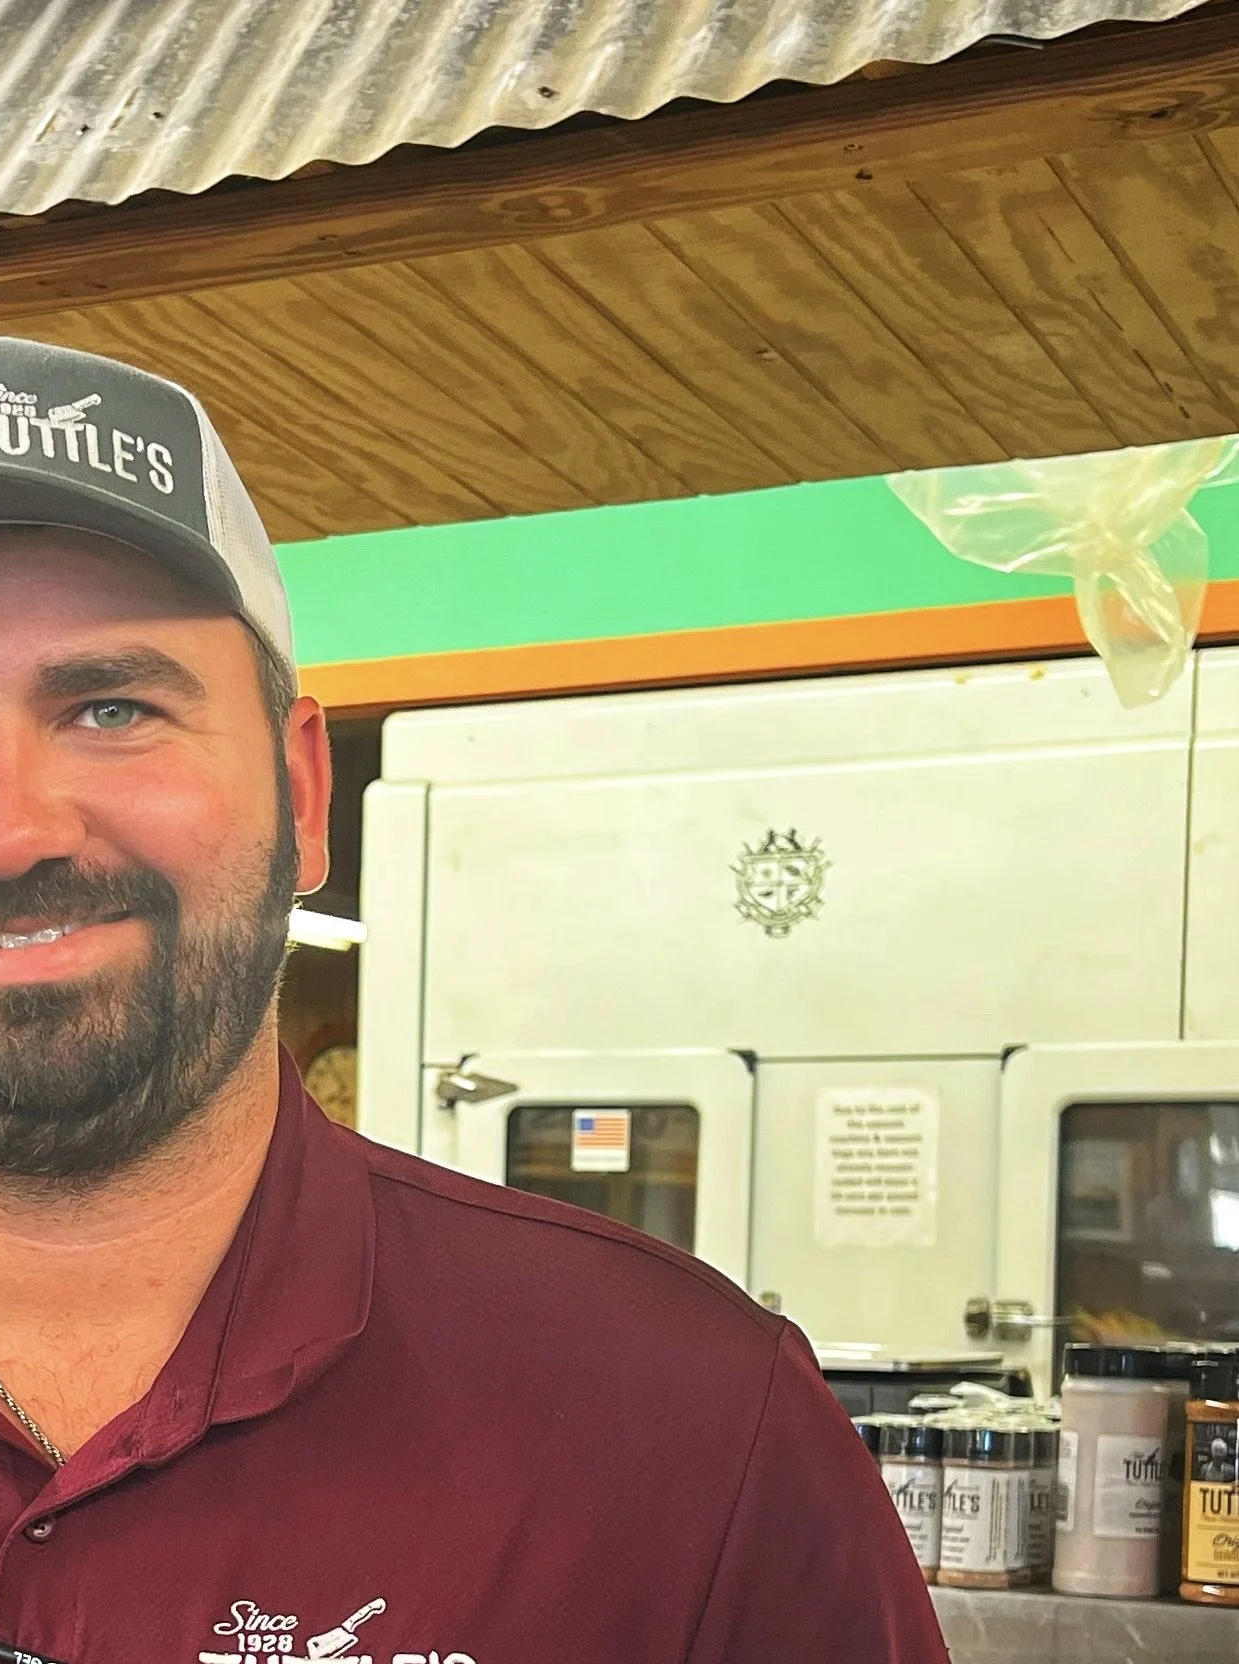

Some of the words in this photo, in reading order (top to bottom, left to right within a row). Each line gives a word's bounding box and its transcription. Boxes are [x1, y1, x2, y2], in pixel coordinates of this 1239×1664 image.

[1200, 1488, 1239, 1515] TUT
[213, 1600, 298, 1635] Since
[237, 1633, 293, 1652] 1928
